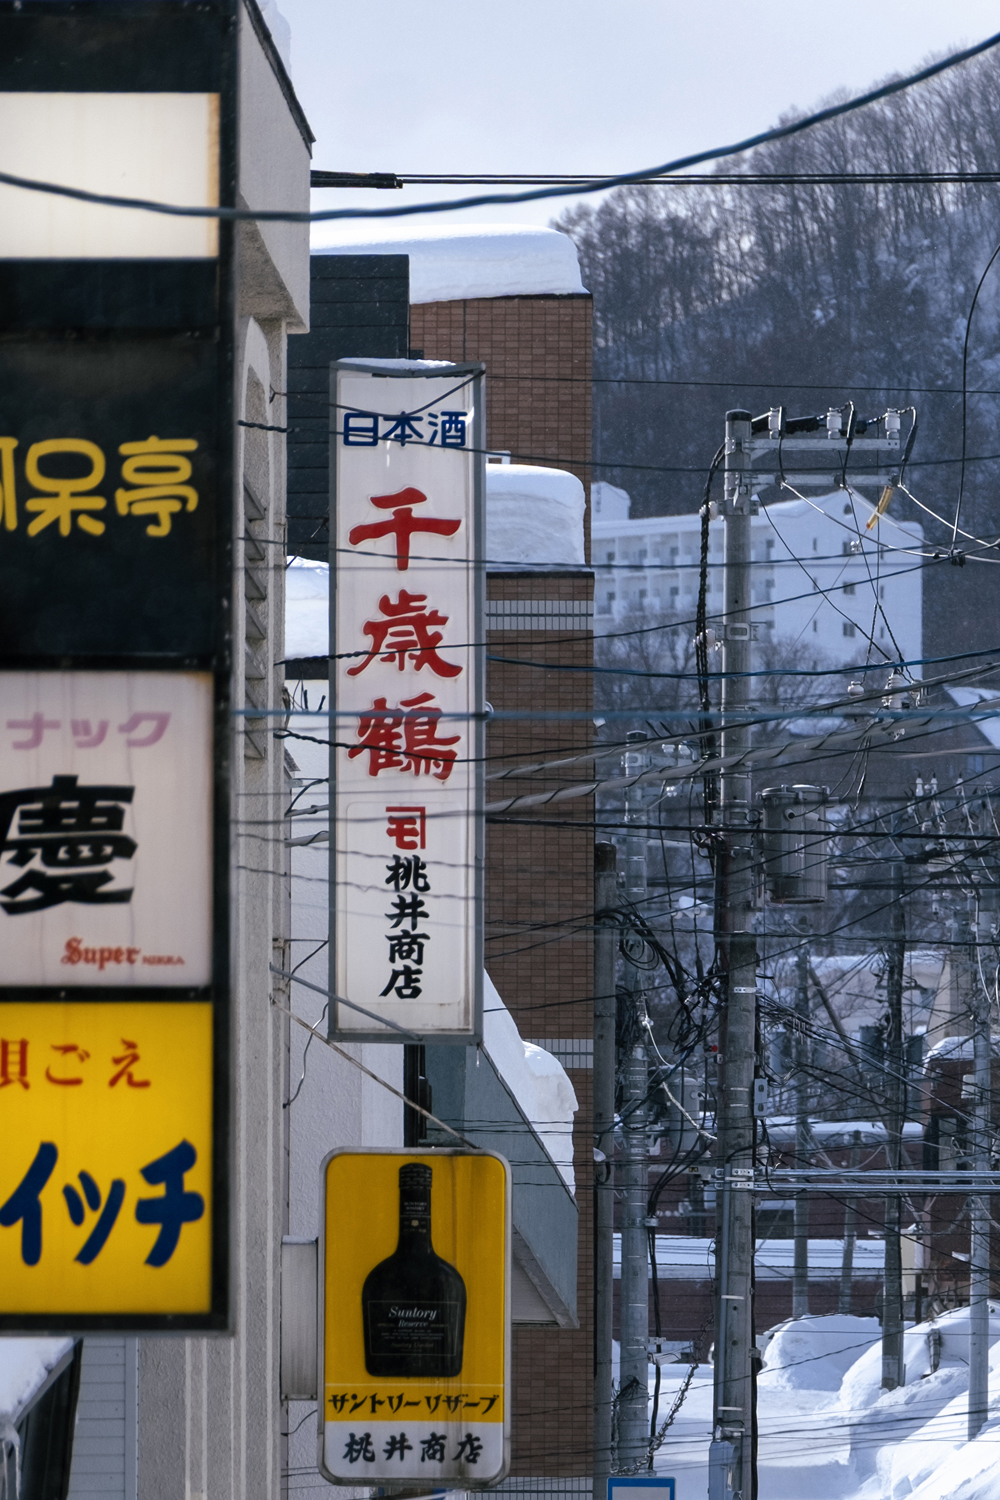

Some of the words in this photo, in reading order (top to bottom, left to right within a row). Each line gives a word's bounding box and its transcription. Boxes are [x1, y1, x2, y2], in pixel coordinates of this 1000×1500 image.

[343, 411, 467, 447] 日本酒
[348, 487, 463, 781] 千歳鶴
[6, 712, 171, 750] ナック
[379, 854, 431, 1000] 桃井商店
[60, 936, 141, 971] Super
[0, 1138, 205, 1268] イッチ
[388, 1306, 438, 1320] Suntory
[328, 1392, 500, 1415] サントリーリザーブ
[342, 1431, 484, 1464] 桃井商店
